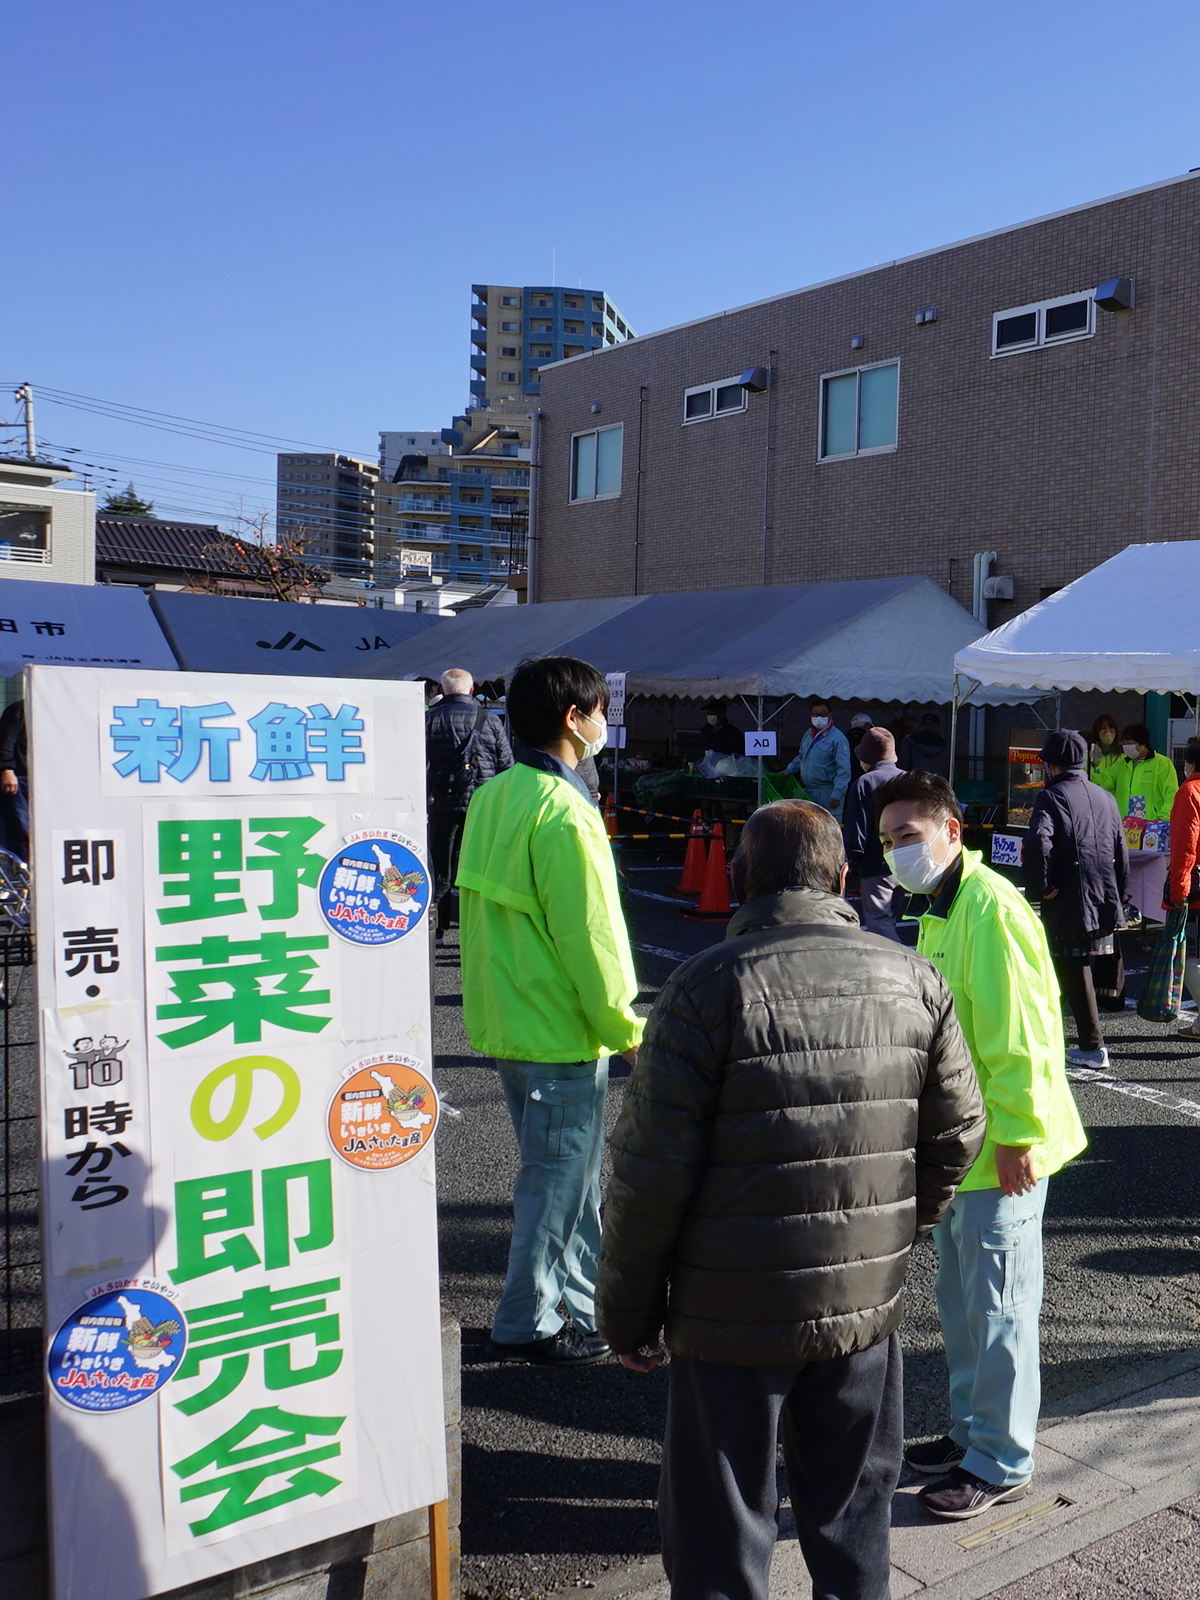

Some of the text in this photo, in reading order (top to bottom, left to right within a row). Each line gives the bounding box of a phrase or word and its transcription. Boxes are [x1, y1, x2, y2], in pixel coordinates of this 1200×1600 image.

[355, 635, 391, 651] JA
[109, 698, 366, 783] 新鮮
[753, 738, 770, 748] 入口
[333, 866, 377, 894] 新鮮
[329, 888, 381, 910] いきいき
[328, 903, 410, 931] JAさいたま産
[339, 1101, 383, 1124] 新鮮
[339, 1121, 392, 1139] いきいき
[342, 1130, 423, 1153] JAさいたま産
[156, 814, 348, 1538] 野菜の即売会
[65, 1325, 122, 1353] 新鮮
[60, 1351, 125, 1371] いきいき
[57, 1368, 160, 1391] JAさいたま産
